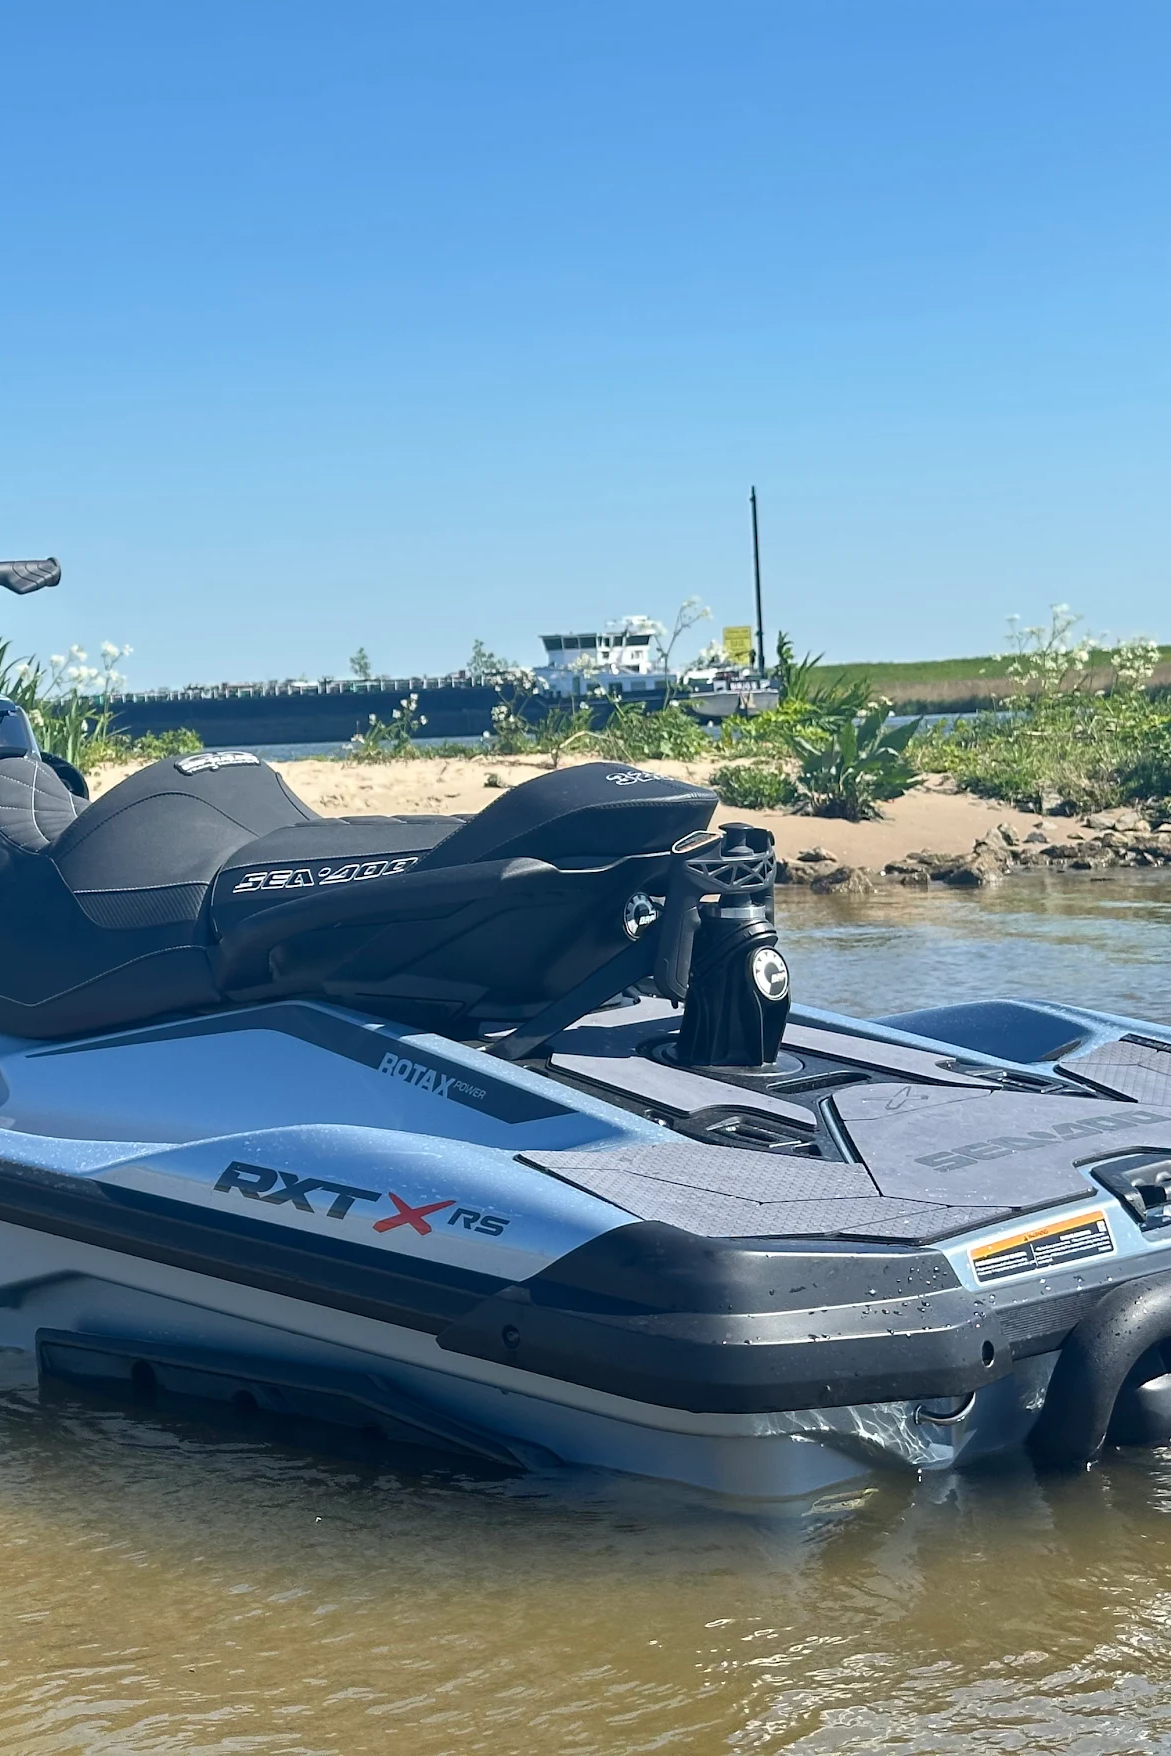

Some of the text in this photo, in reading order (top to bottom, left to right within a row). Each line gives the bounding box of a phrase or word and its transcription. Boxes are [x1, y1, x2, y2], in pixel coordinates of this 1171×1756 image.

[377, 1052, 487, 1100] ROTAX POWER
[213, 1160, 511, 1237] RXT X RS
